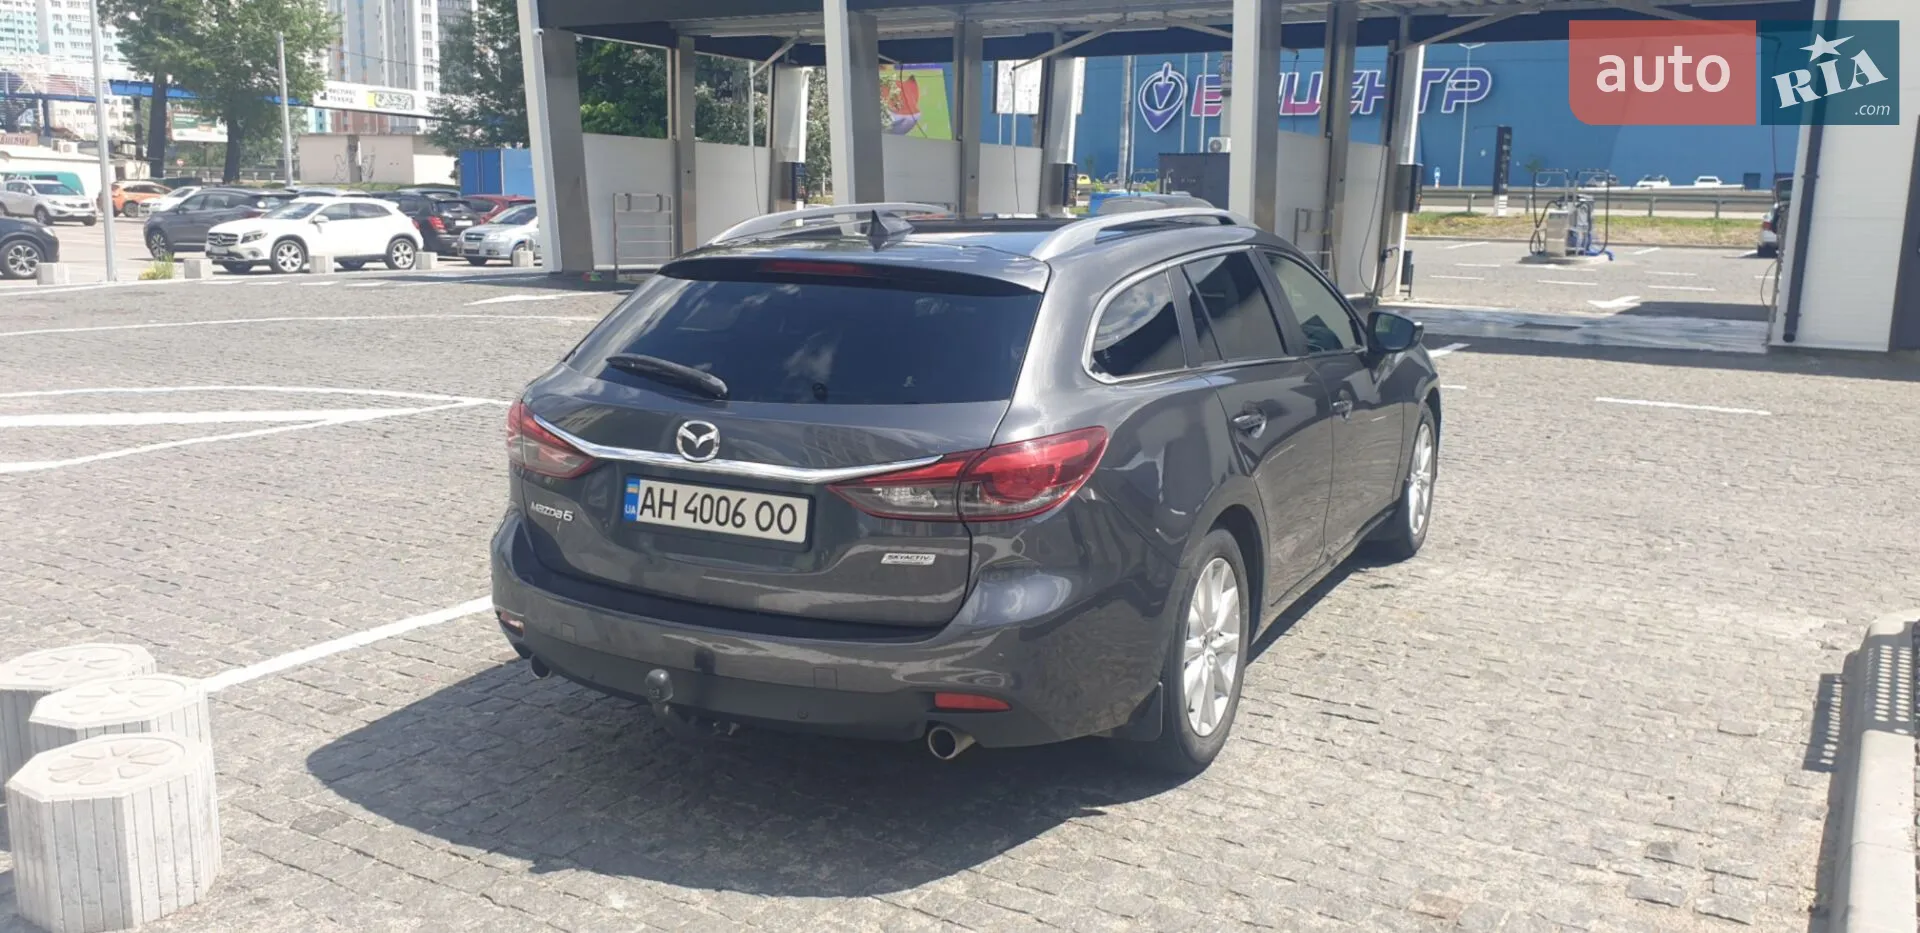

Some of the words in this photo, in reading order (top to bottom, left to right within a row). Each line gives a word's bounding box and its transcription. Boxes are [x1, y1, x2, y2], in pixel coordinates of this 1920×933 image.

[624, 503, 637, 515] UA
[639, 486, 678, 521] AH
[683, 492, 748, 529] 4006
[754, 500, 798, 535] OO
